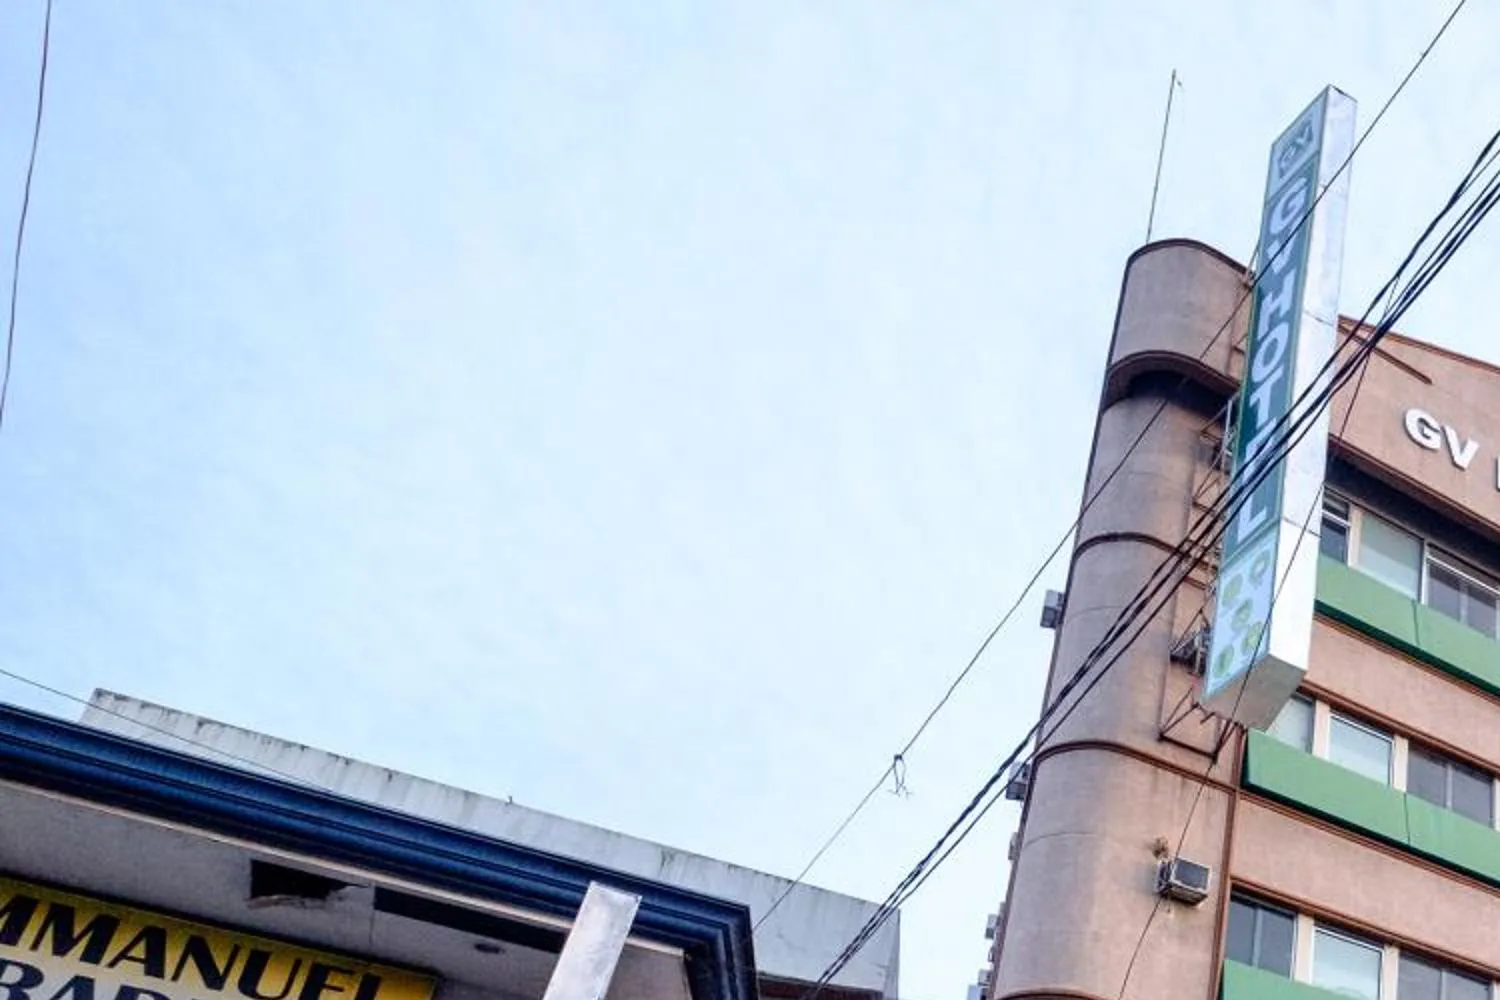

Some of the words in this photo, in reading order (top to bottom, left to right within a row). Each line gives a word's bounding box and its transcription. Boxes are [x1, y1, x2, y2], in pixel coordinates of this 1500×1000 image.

[1266, 177, 1307, 274] GV
[1237, 268, 1297, 543] HOTEL
[1404, 408, 1479, 471] GV
